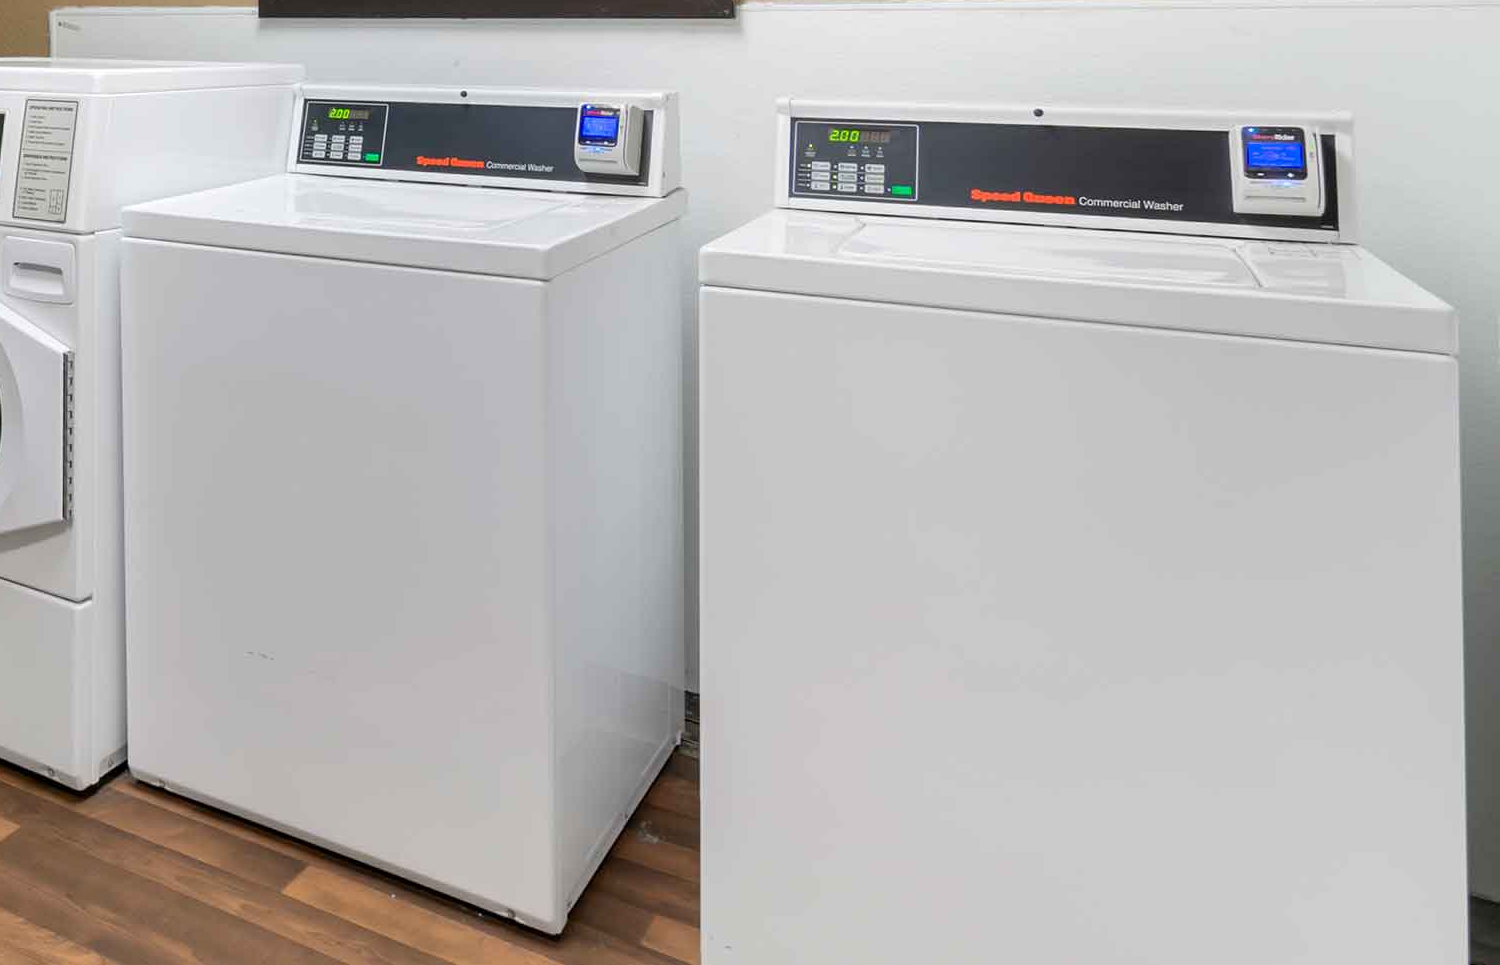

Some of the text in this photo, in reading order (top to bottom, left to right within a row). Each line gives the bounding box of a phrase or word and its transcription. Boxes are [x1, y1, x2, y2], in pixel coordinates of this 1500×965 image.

[486, 160, 527, 171] Commercial
[528, 163, 554, 173] Washer
[970, 188, 1184, 212] Speed Queen Commercial Washer
